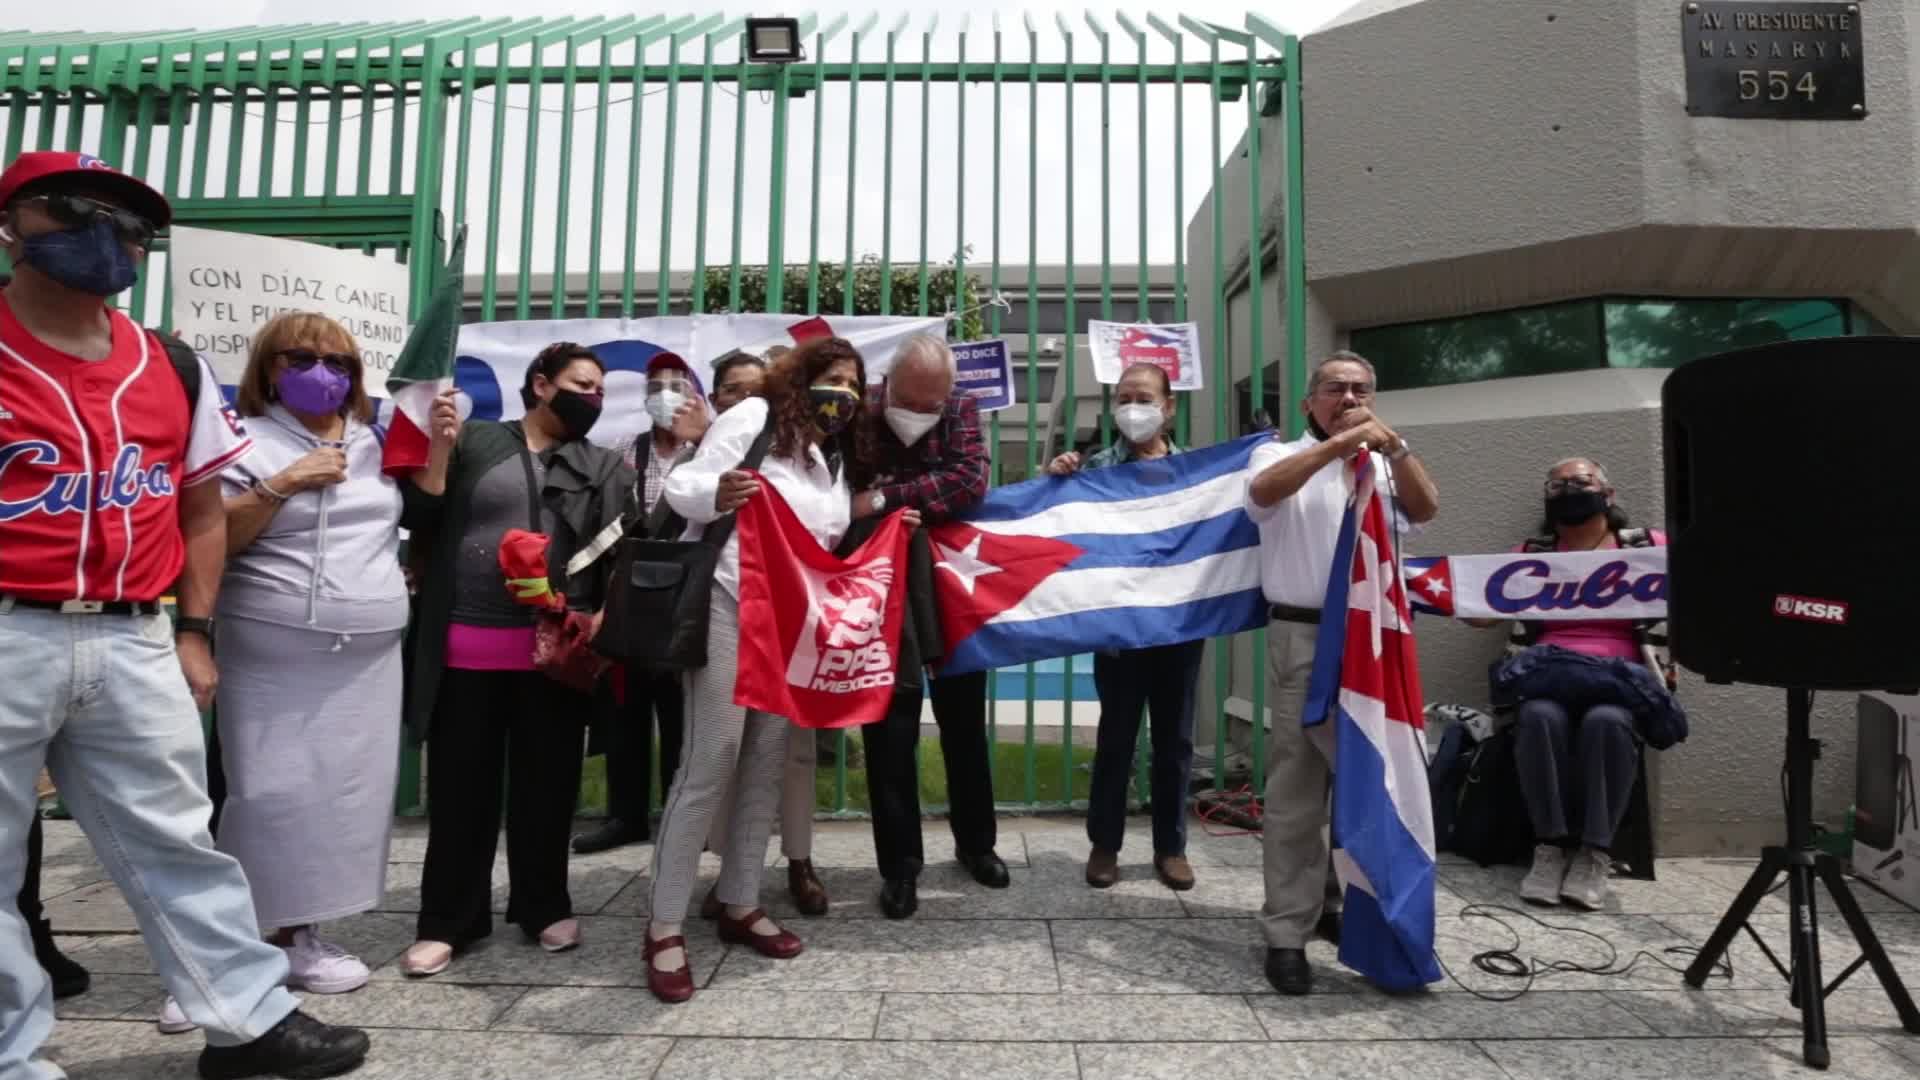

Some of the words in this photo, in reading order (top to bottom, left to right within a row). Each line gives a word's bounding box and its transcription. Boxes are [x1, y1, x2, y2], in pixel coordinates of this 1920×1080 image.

[1736, 12, 1850, 30] PRESIDENTE
[1738, 69, 1817, 102] 554
[190, 267, 242, 289] CON
[262, 269, 325, 301] DÍAZ
[335, 284, 399, 316] CANEL
[191, 301, 206, 319] Y
[215, 302, 239, 323] EL
[358, 349, 396, 372] ODO
[0, 439, 175, 522] Cuba
[1485, 559, 1668, 614] Cuba
[1794, 600, 1845, 621] KSR
[816, 640, 892, 678] PPS
[812, 671, 895, 694] MEXICO
